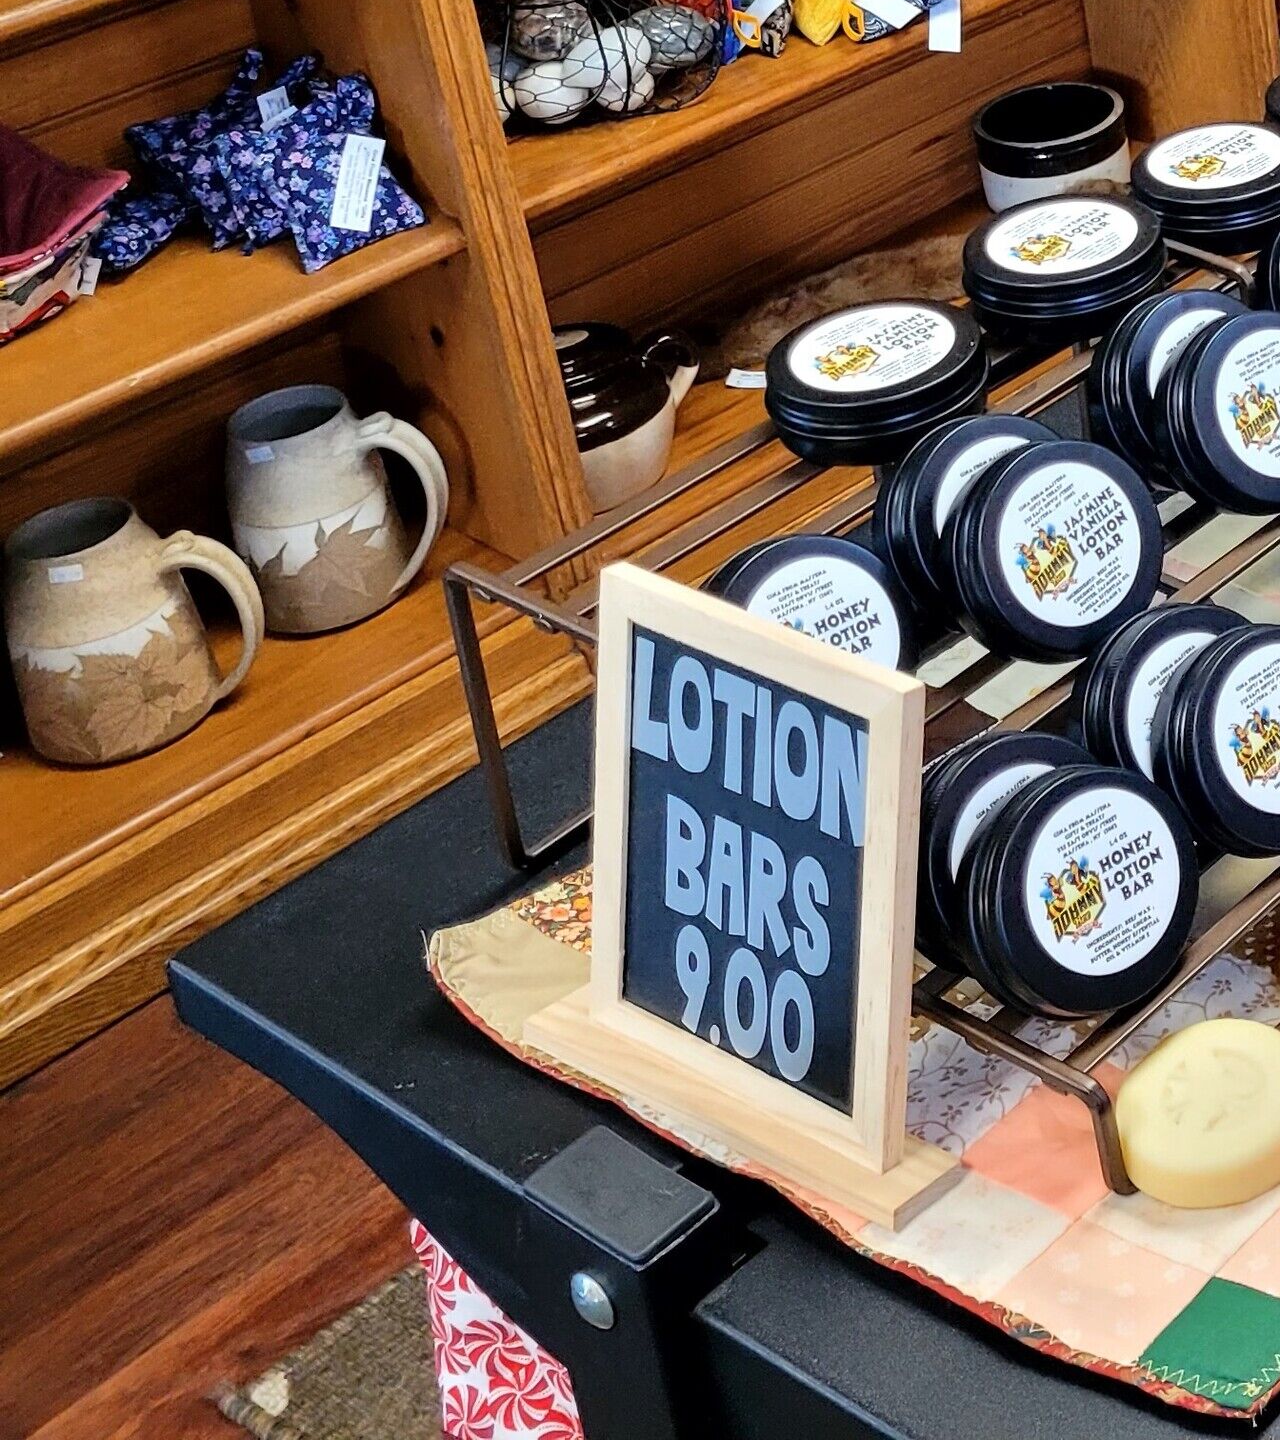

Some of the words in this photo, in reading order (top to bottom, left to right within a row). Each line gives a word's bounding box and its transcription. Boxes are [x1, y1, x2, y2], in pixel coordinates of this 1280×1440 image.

[1213, 134, 1256, 156] LOTION
[1230, 142, 1255, 155] BAR
[1065, 212, 1111, 237] LOTION
[1082, 222, 1111, 236] BAR
[866, 313, 925, 342] JASMINE
[871, 318, 936, 345] VANILLA
[881, 323, 940, 351] LOTION
[902, 334, 935, 350] BAR
[1064, 486, 1115, 532] JASMINE
[1069, 499, 1122, 542] VANILLA
[1078, 511, 1128, 555] LOTION
[1094, 533, 1124, 561] BAR
[814, 597, 870, 636] HONEY
[830, 613, 882, 646] OTION
[851, 636, 873, 654] AR
[632, 635, 870, 847] LOTION
[1099, 831, 1152, 873] HONEY
[1104, 846, 1163, 892] LOTION
[664, 793, 830, 977] BARS
[1120, 871, 1154, 900] BAR
[675, 924, 815, 1082] 9.00
